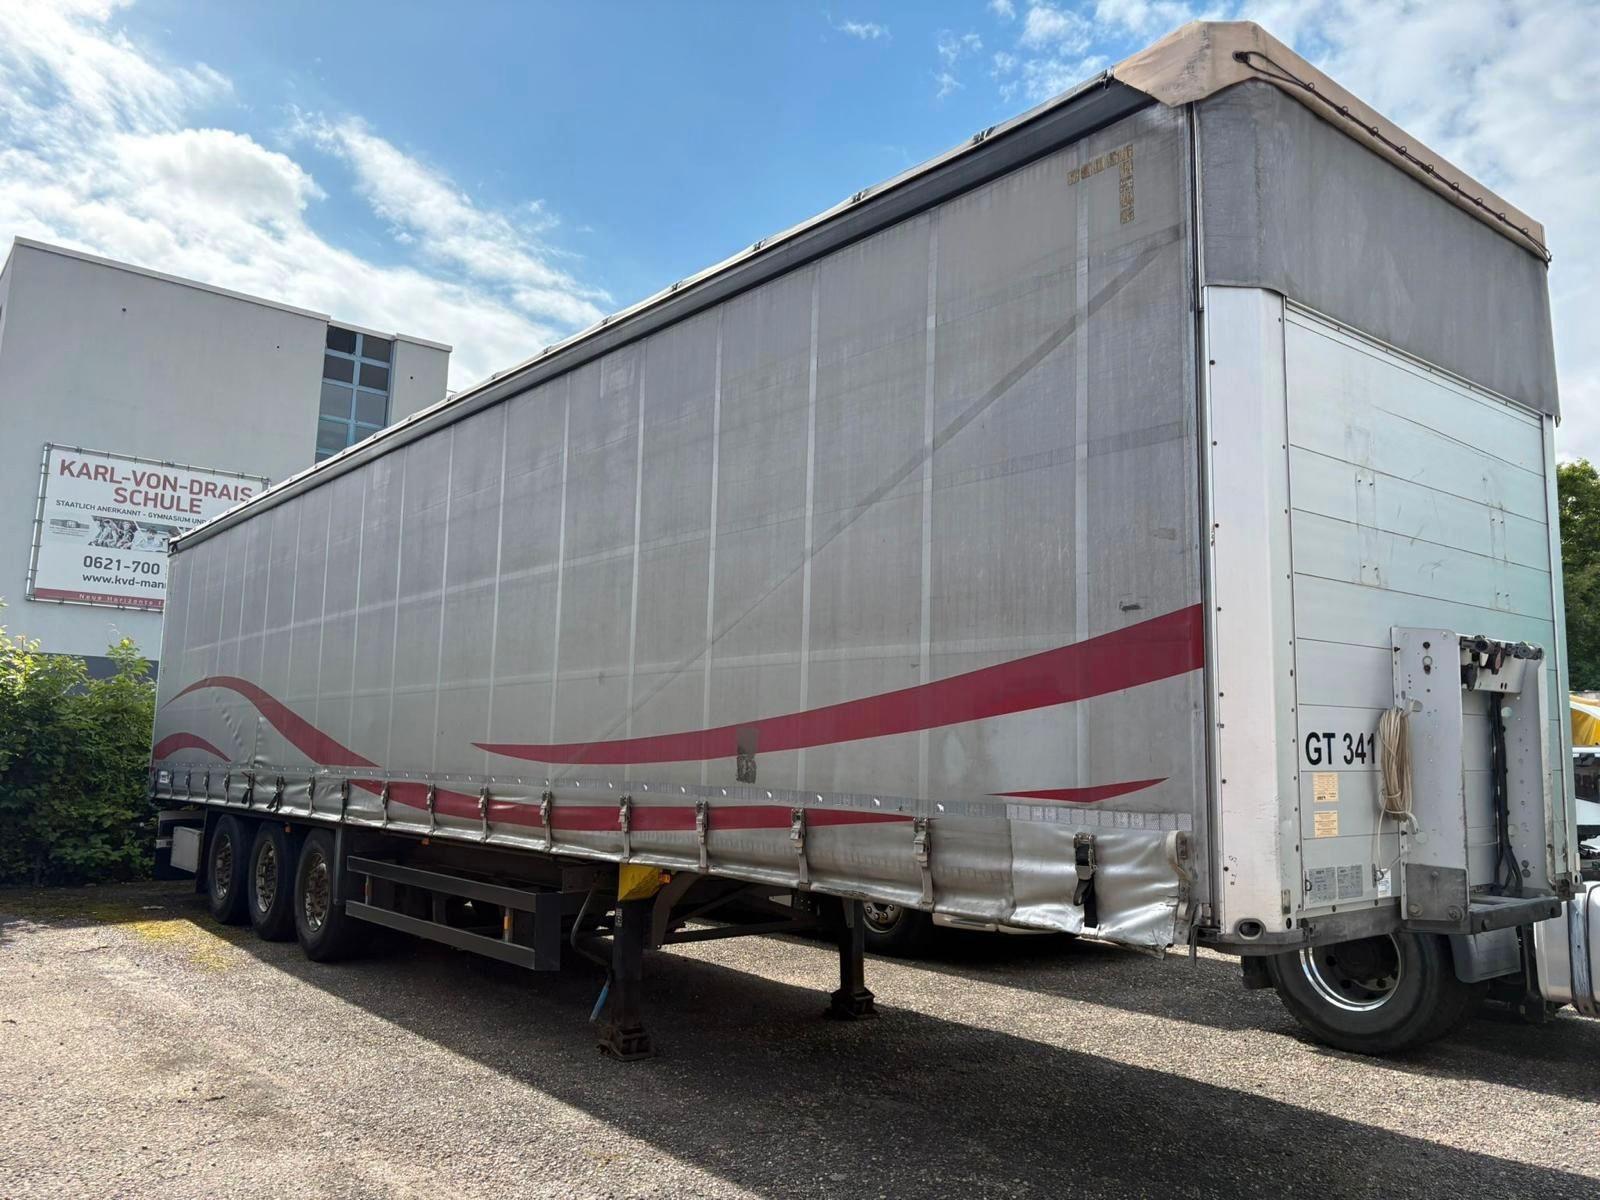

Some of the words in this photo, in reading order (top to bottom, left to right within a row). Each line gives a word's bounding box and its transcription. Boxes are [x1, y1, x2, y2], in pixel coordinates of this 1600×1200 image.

[59, 459, 253, 502] KARL-VON-DRAIS
[56, 499, 95, 511] STAATLICH
[97, 505, 141, 517] ANERKANNT
[148, 512, 191, 524] GYMNASIUM
[113, 487, 203, 514] SCHULE
[83, 555, 160, 575] 0621-700
[82, 574, 167, 590] www.kvd-man
[80, 593, 102, 601] Neue
[1305, 731, 1336, 766] GT
[1343, 732, 1376, 766] 341
